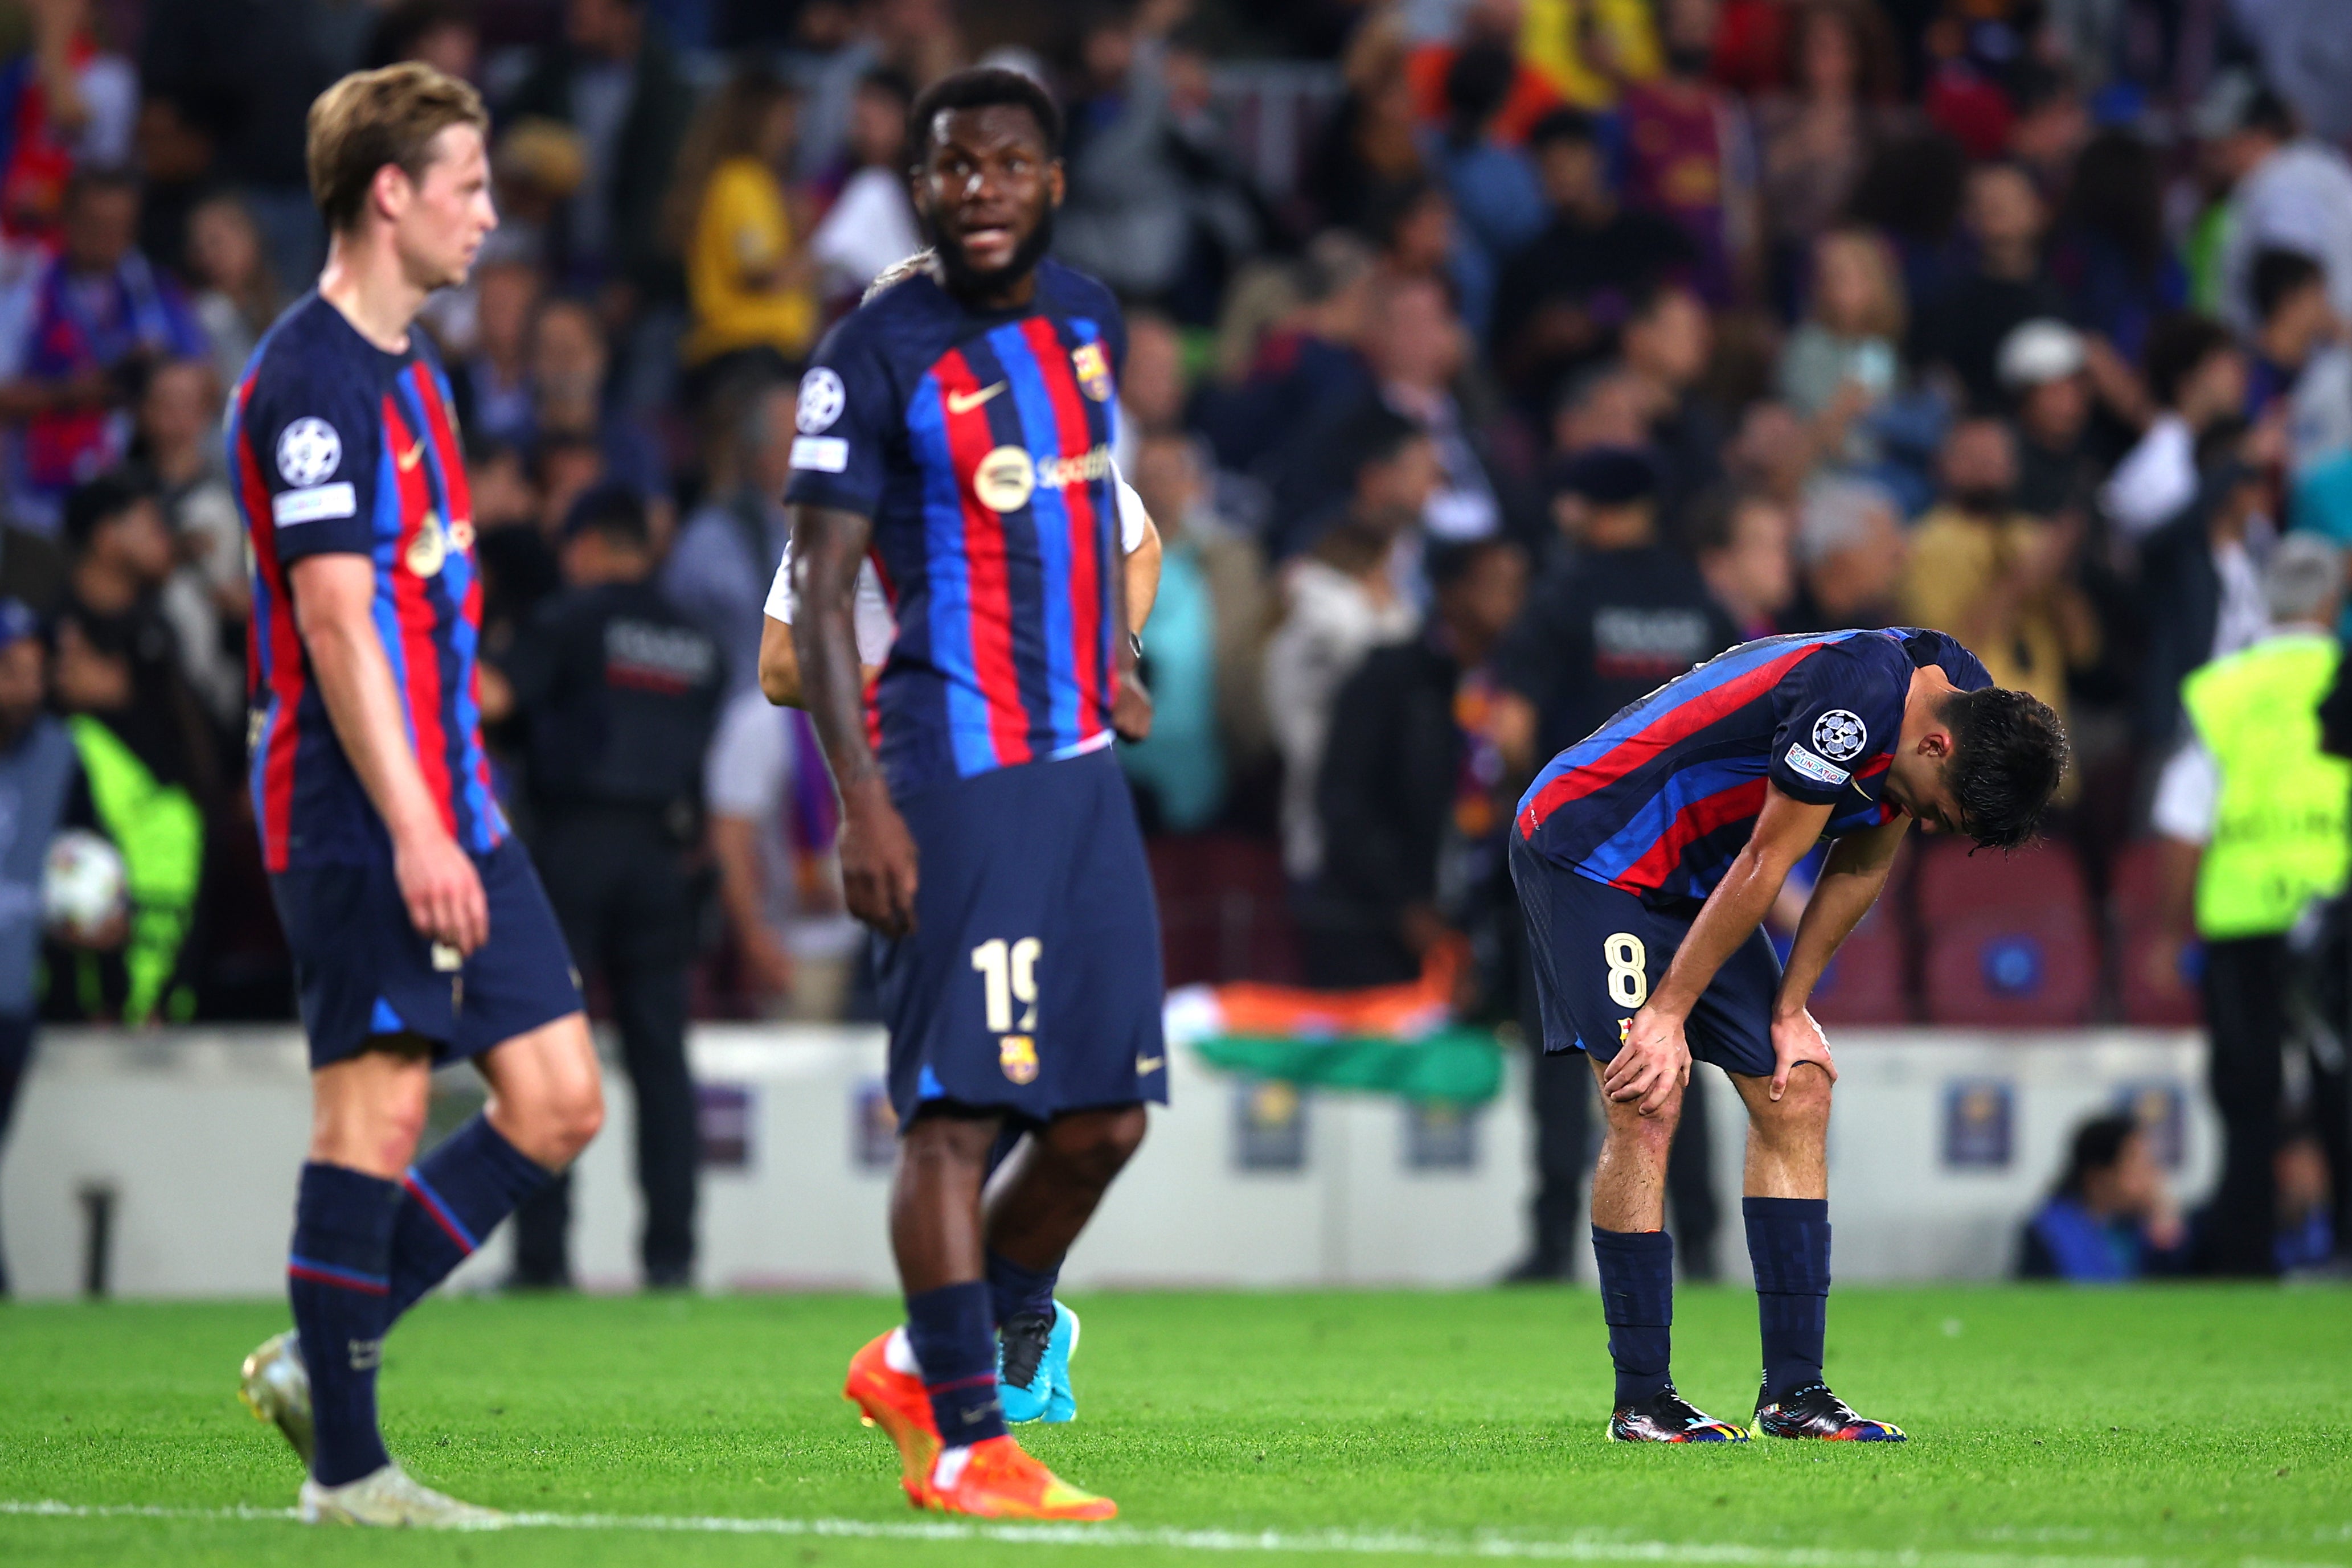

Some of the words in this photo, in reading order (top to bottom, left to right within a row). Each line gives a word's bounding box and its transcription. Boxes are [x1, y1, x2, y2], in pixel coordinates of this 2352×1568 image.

[1793, 745, 1806, 757] UEFA
[1830, 726, 1850, 744] 5
[1789, 749, 1845, 782] FOUNDATION
[970, 937, 1043, 1033] 19
[1603, 932, 1648, 1009] 8
